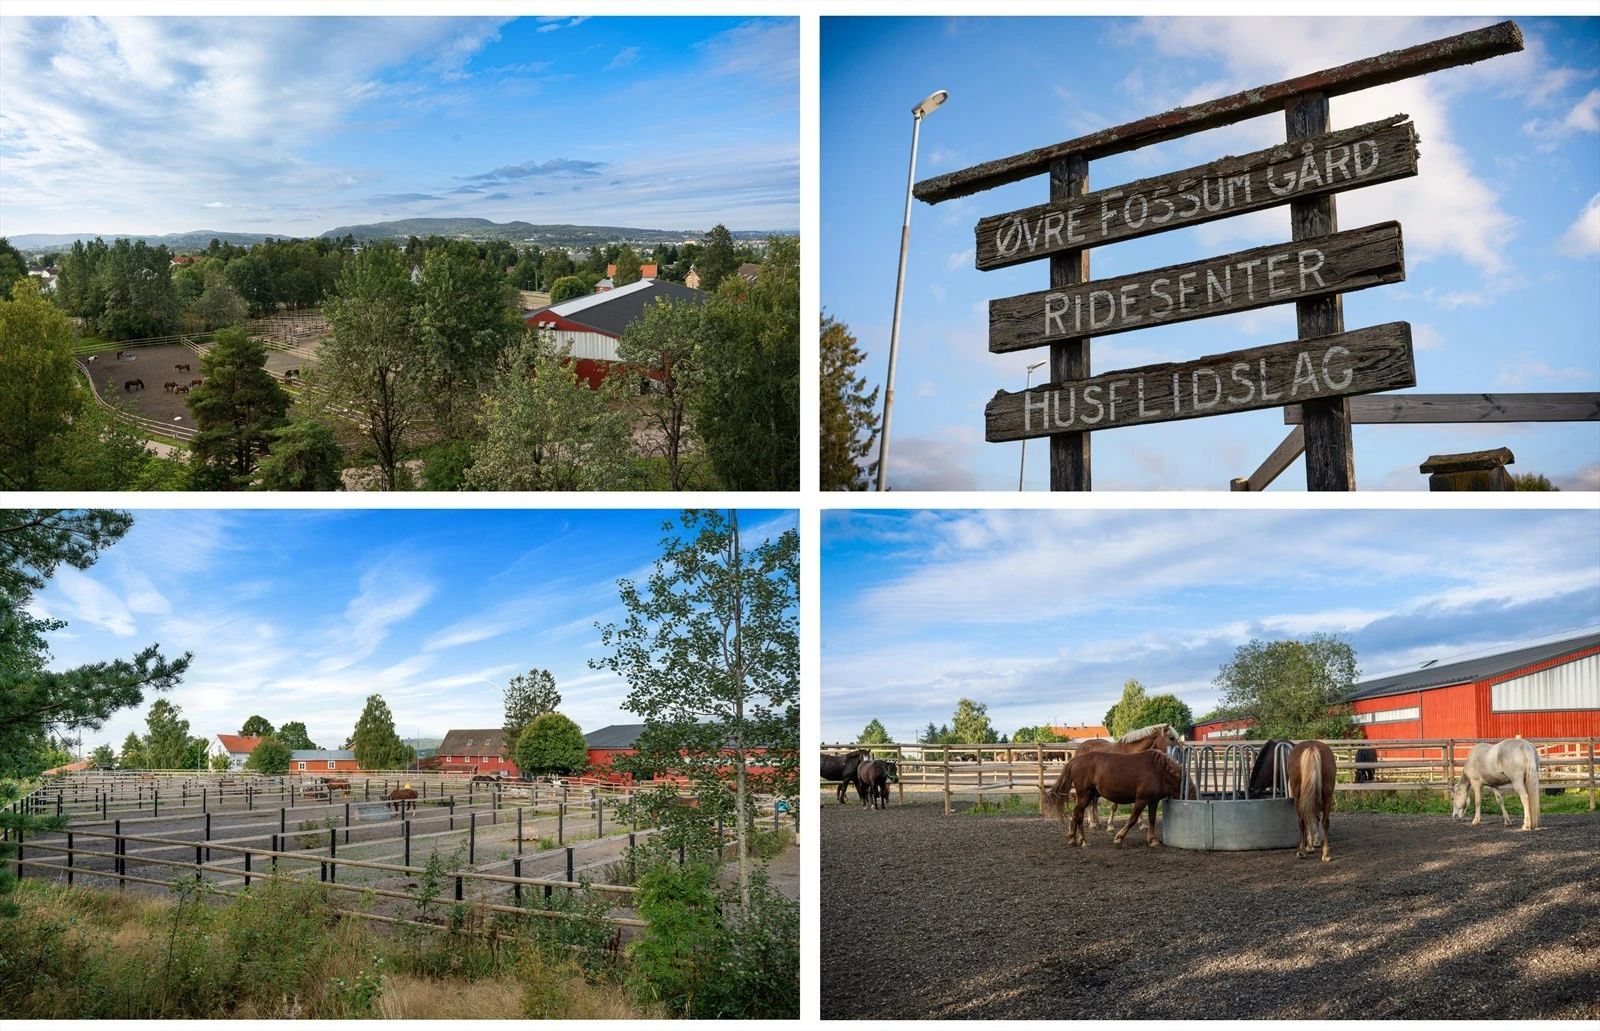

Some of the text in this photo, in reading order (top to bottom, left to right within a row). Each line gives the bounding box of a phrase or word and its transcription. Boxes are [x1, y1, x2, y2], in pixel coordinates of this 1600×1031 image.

[995, 138, 1380, 258] ØVRE FOSSUM GÅRD
[1044, 248, 1327, 338] RIDESENTER
[1023, 345, 1355, 432] HUSFLIDSLAG
